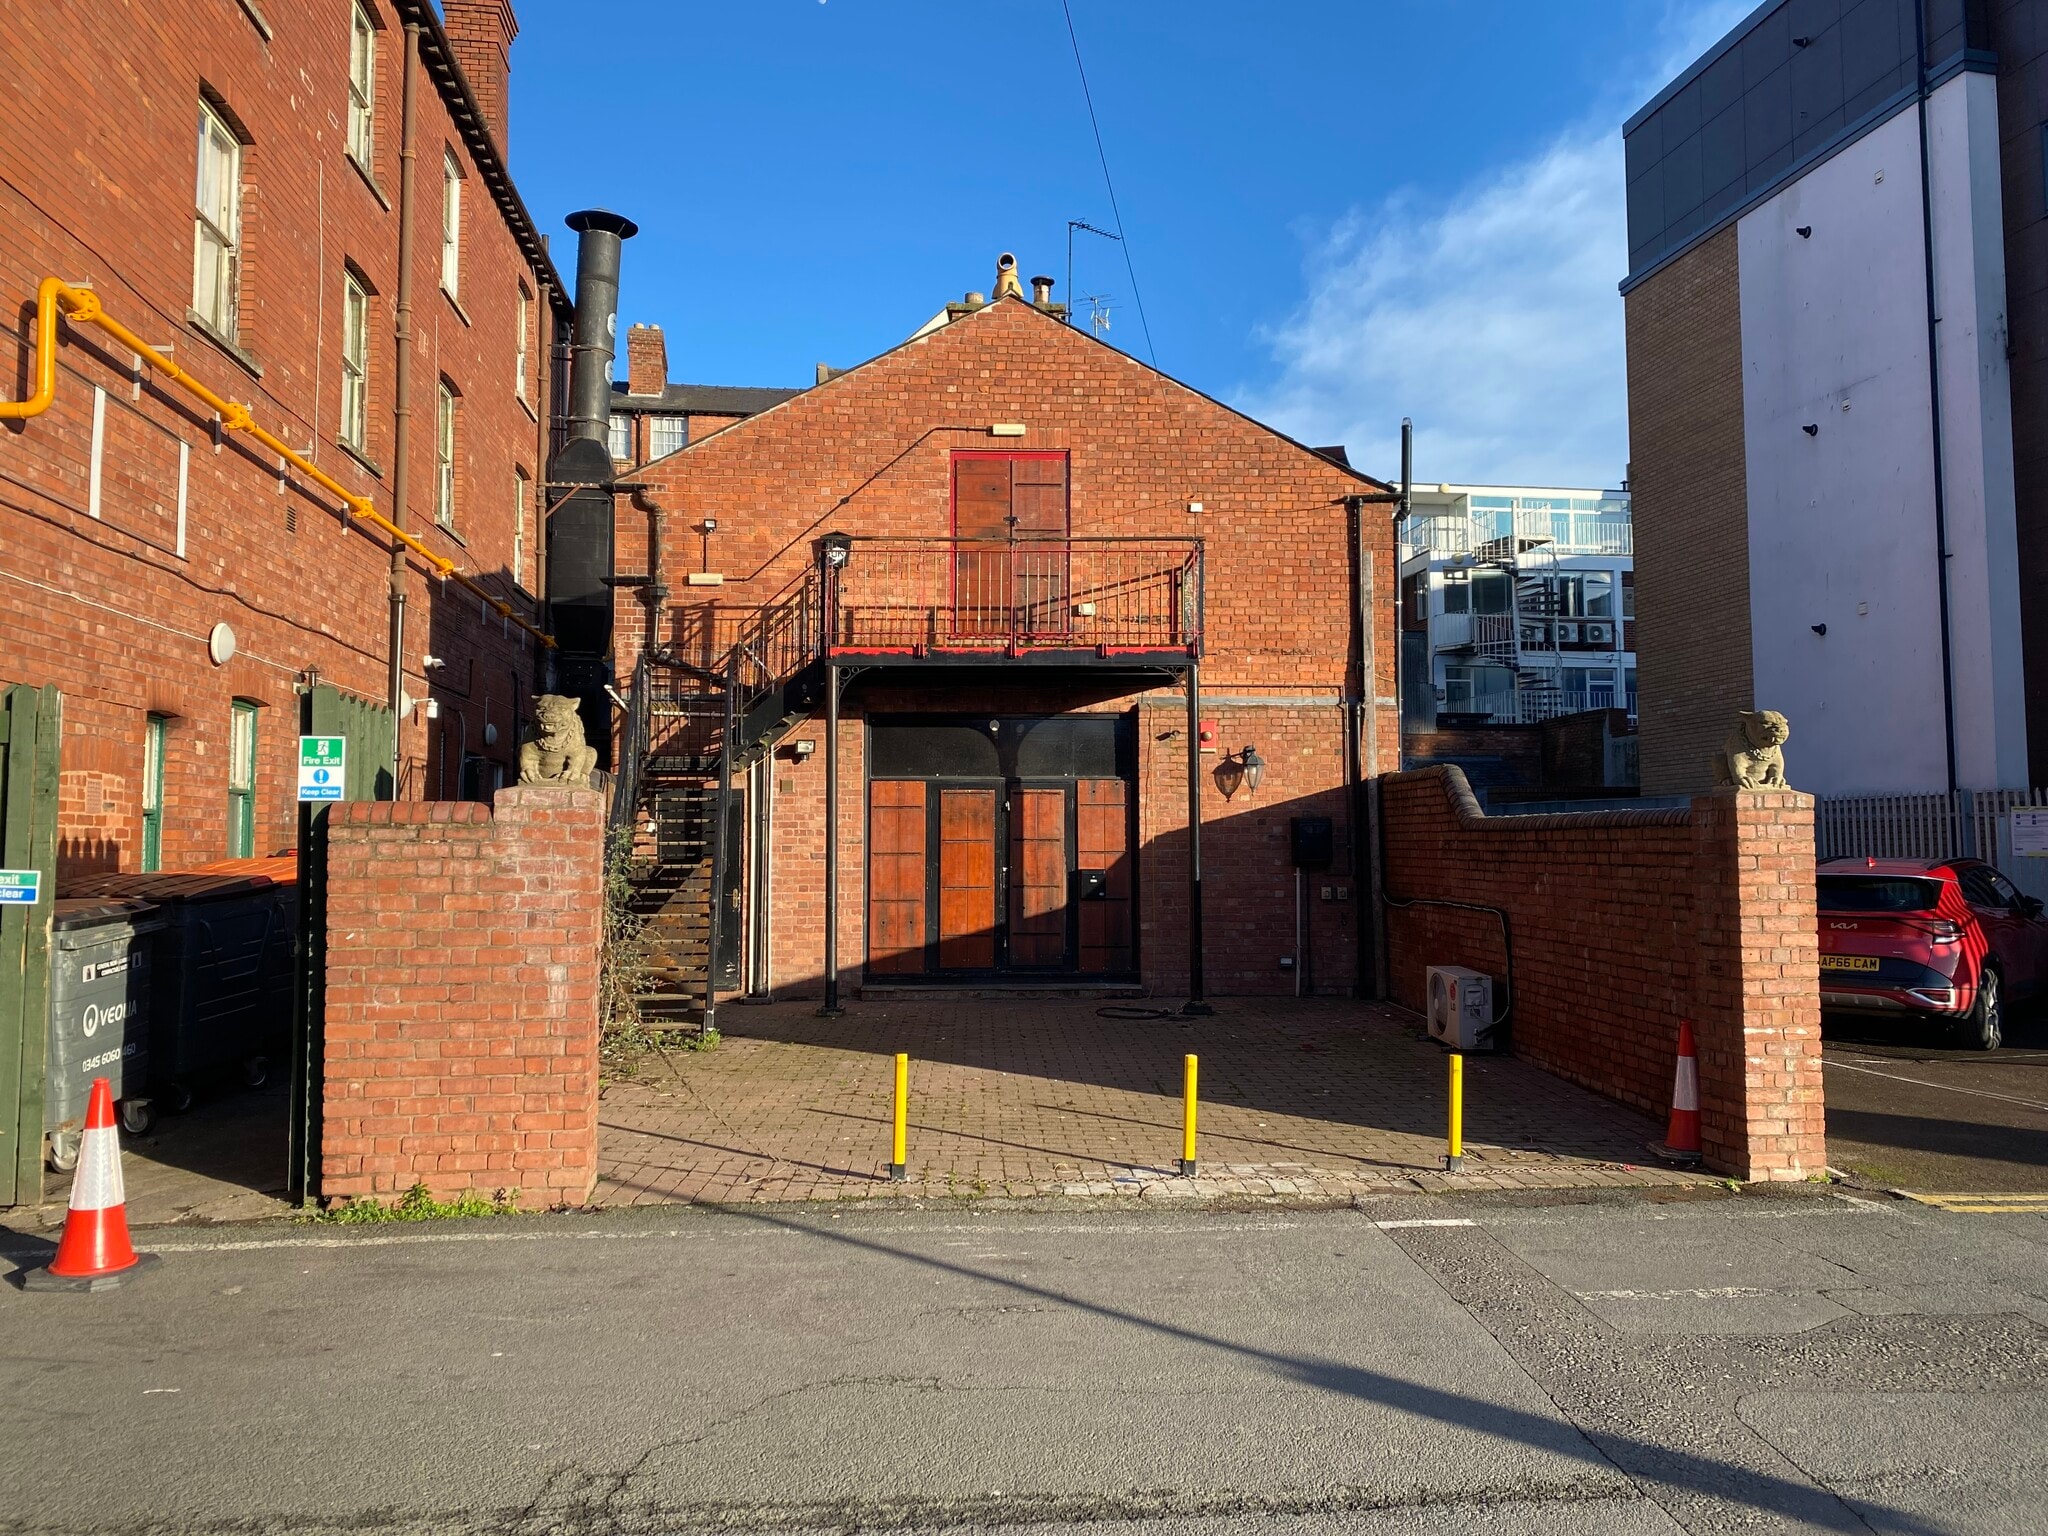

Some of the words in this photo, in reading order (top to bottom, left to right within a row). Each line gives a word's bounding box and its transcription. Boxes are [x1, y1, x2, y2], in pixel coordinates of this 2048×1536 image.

[303, 756, 321, 765] Fire
[322, 756, 341, 765] Exit
[301, 788, 319, 797] Keep
[320, 788, 340, 796] Clear
[0, 874, 20, 885] exit
[0, 888, 24, 899] lear
[1821, 957, 1851, 968] AP66
[1854, 958, 1877, 969] CAM
[99, 999, 138, 1027] VEOLIA
[82, 1054, 101, 1073] 0345
[101, 1048, 121, 1066] 6060
